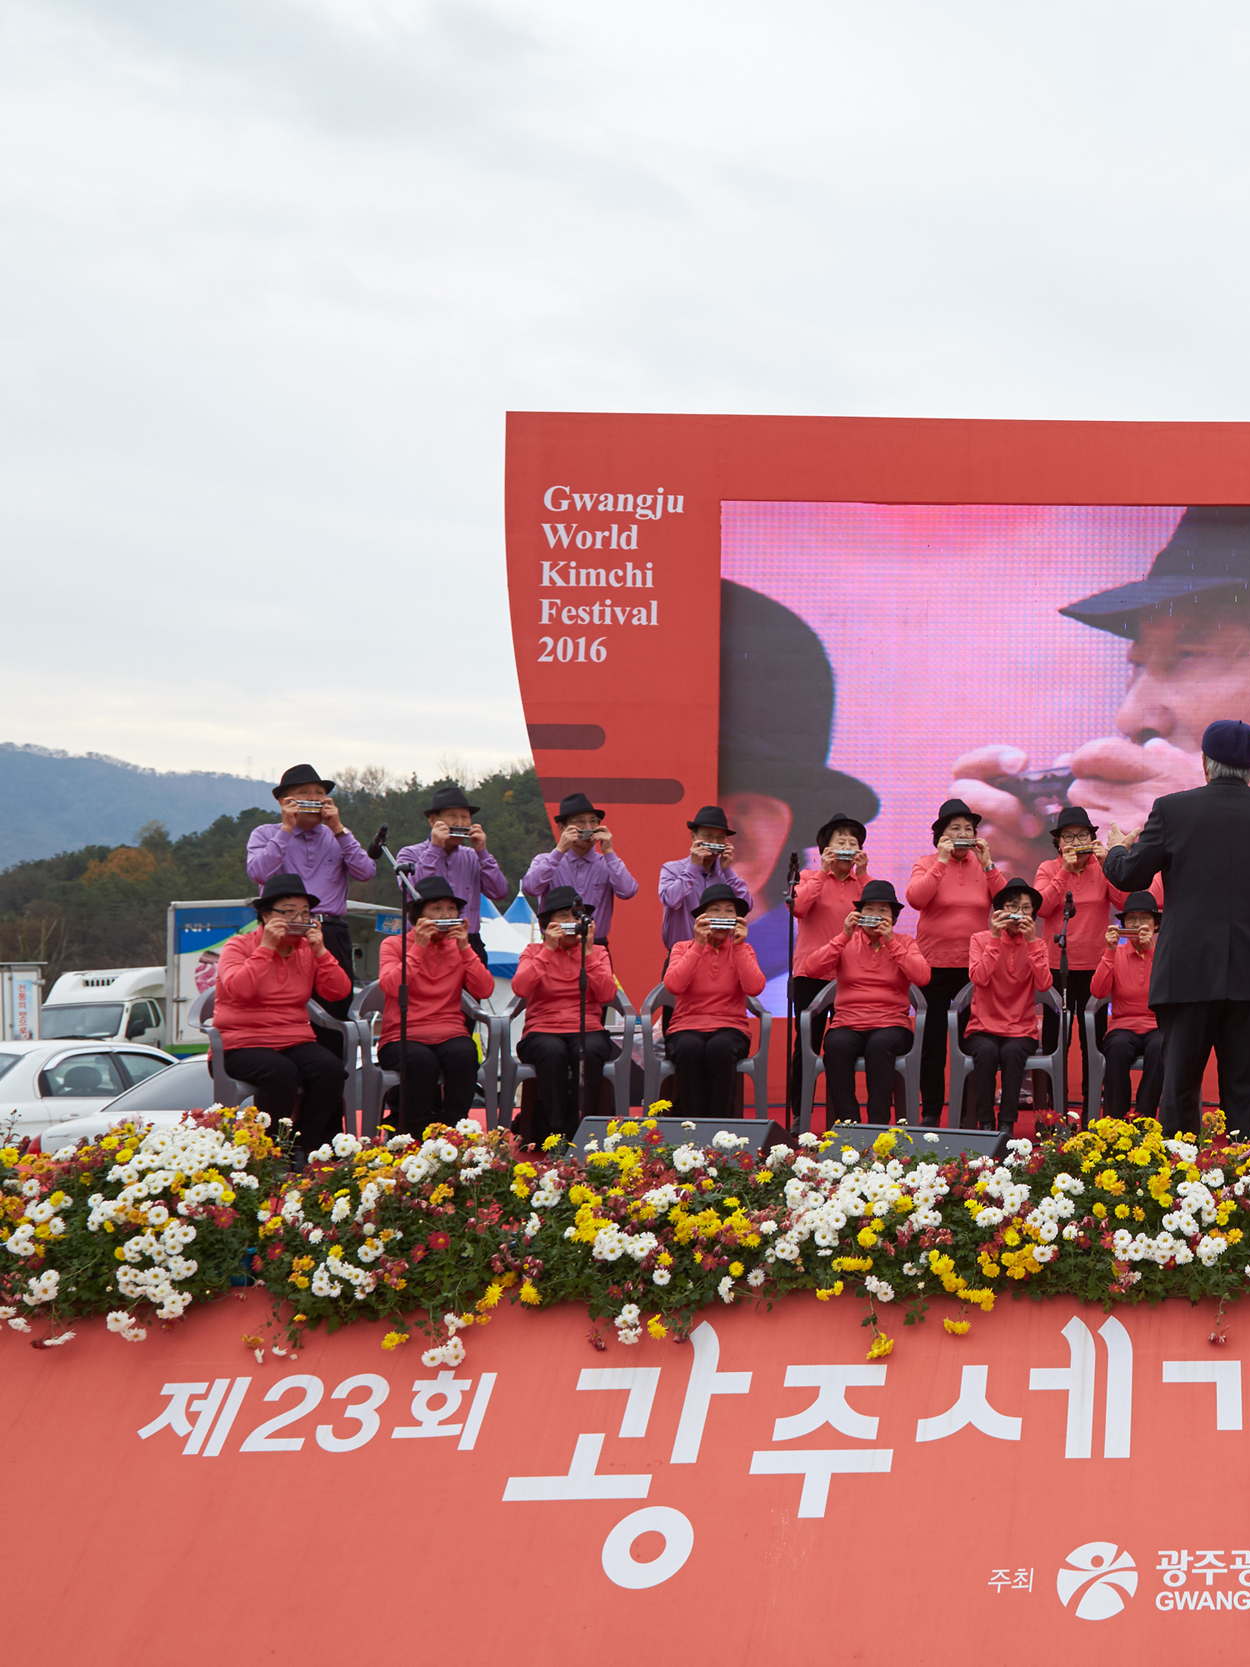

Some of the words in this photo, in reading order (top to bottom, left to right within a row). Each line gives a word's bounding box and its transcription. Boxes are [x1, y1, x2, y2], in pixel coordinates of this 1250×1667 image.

[543, 485, 685, 520] Gwangju
[541, 523, 638, 550] World
[540, 561, 654, 588] Kimchi
[539, 599, 659, 626] Festival
[537, 636, 608, 663] 2016
[136, 1371, 498, 1457] 제23회
[987, 1567, 1035, 1594] 주최
